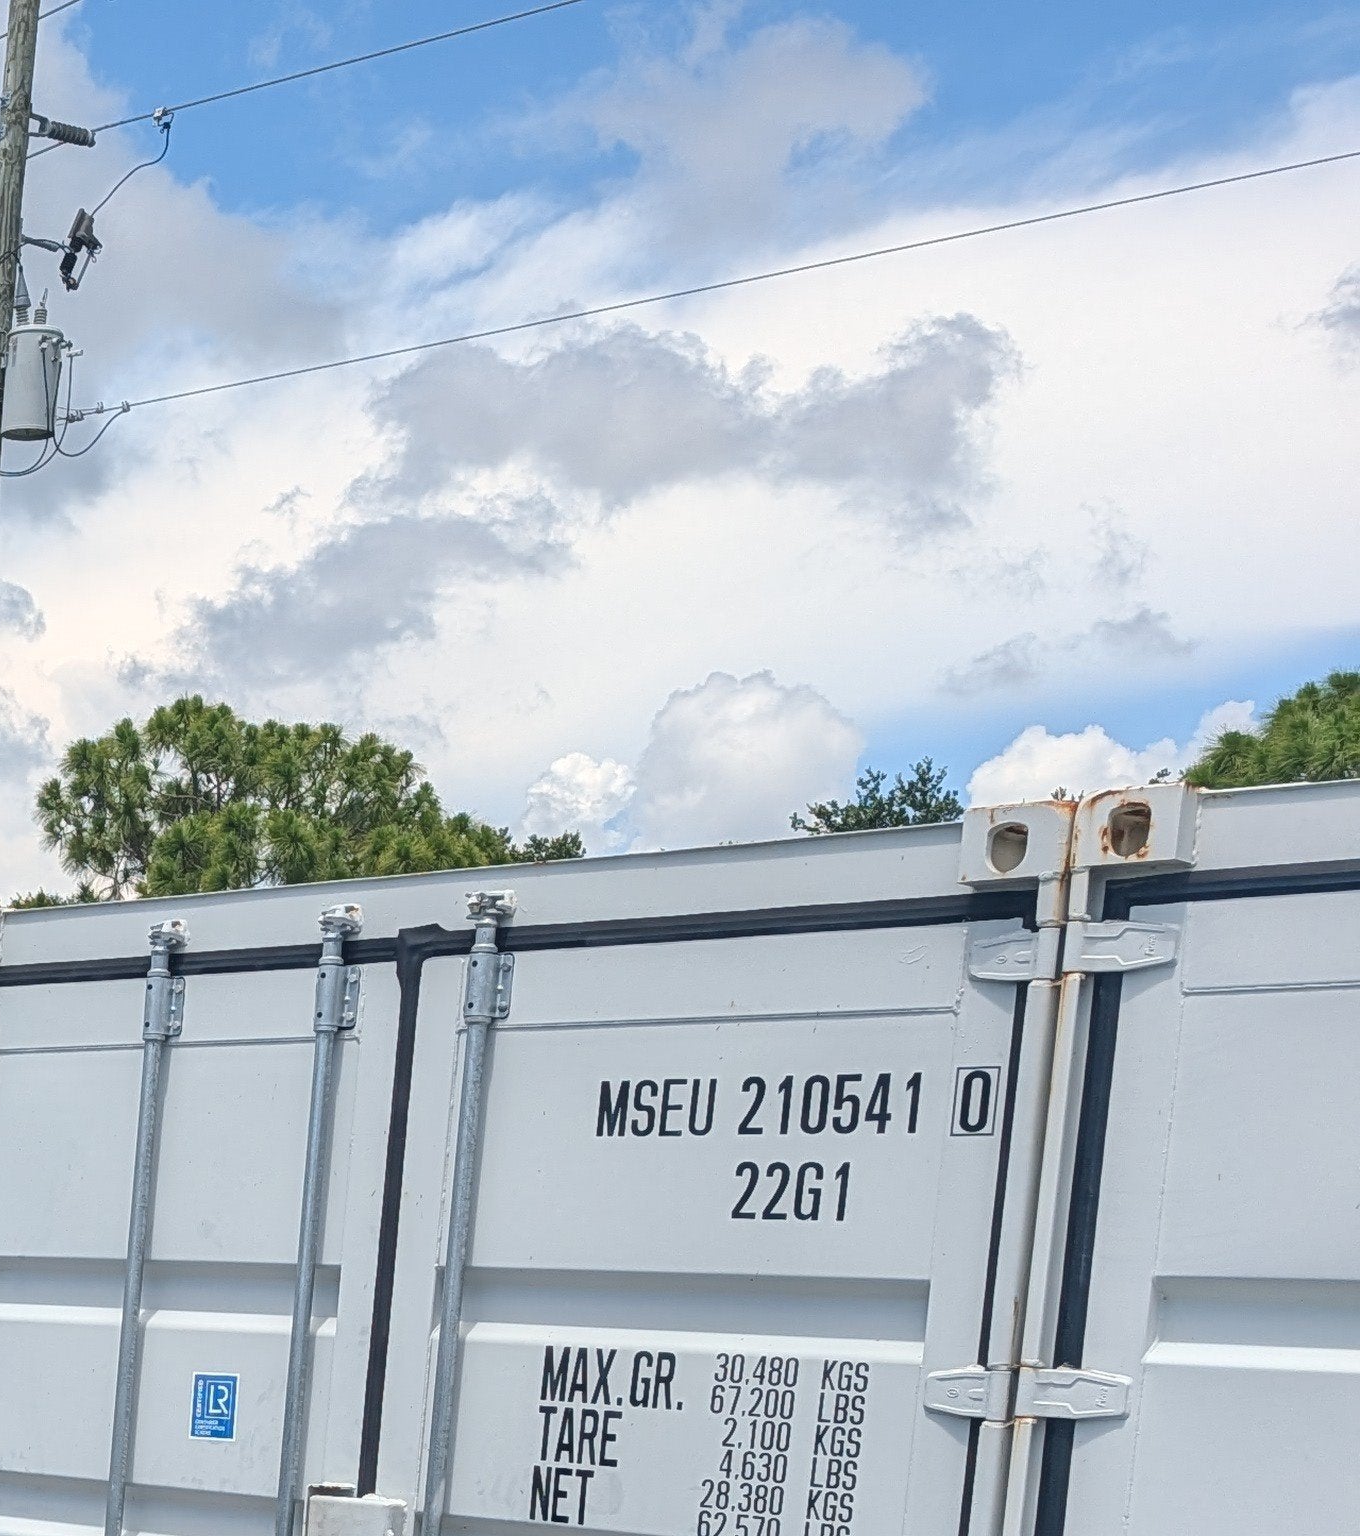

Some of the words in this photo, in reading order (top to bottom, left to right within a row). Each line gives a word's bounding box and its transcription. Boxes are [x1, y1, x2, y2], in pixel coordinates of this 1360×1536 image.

[596, 1078, 717, 1137] MSEU
[738, 1072, 922, 1135] 210541
[958, 1070, 992, 1132] 0
[731, 1161, 851, 1222] 22G1
[714, 1353, 800, 1388] 30,480
[821, 1359, 870, 1392] KGS
[710, 1385, 795, 1420] 67,200
[817, 1392, 866, 1425] LBS
[538, 1405, 623, 1468] TARE
[722, 1417, 792, 1452] 2,100
[812, 1424, 862, 1458] KGS
[530, 1465, 594, 1526] NET
[699, 1478, 784, 1516] 28,380
[805, 1489, 855, 1524] KGS
[718, 1450, 788, 1484] 4,630
[809, 1457, 858, 1490] LBS
